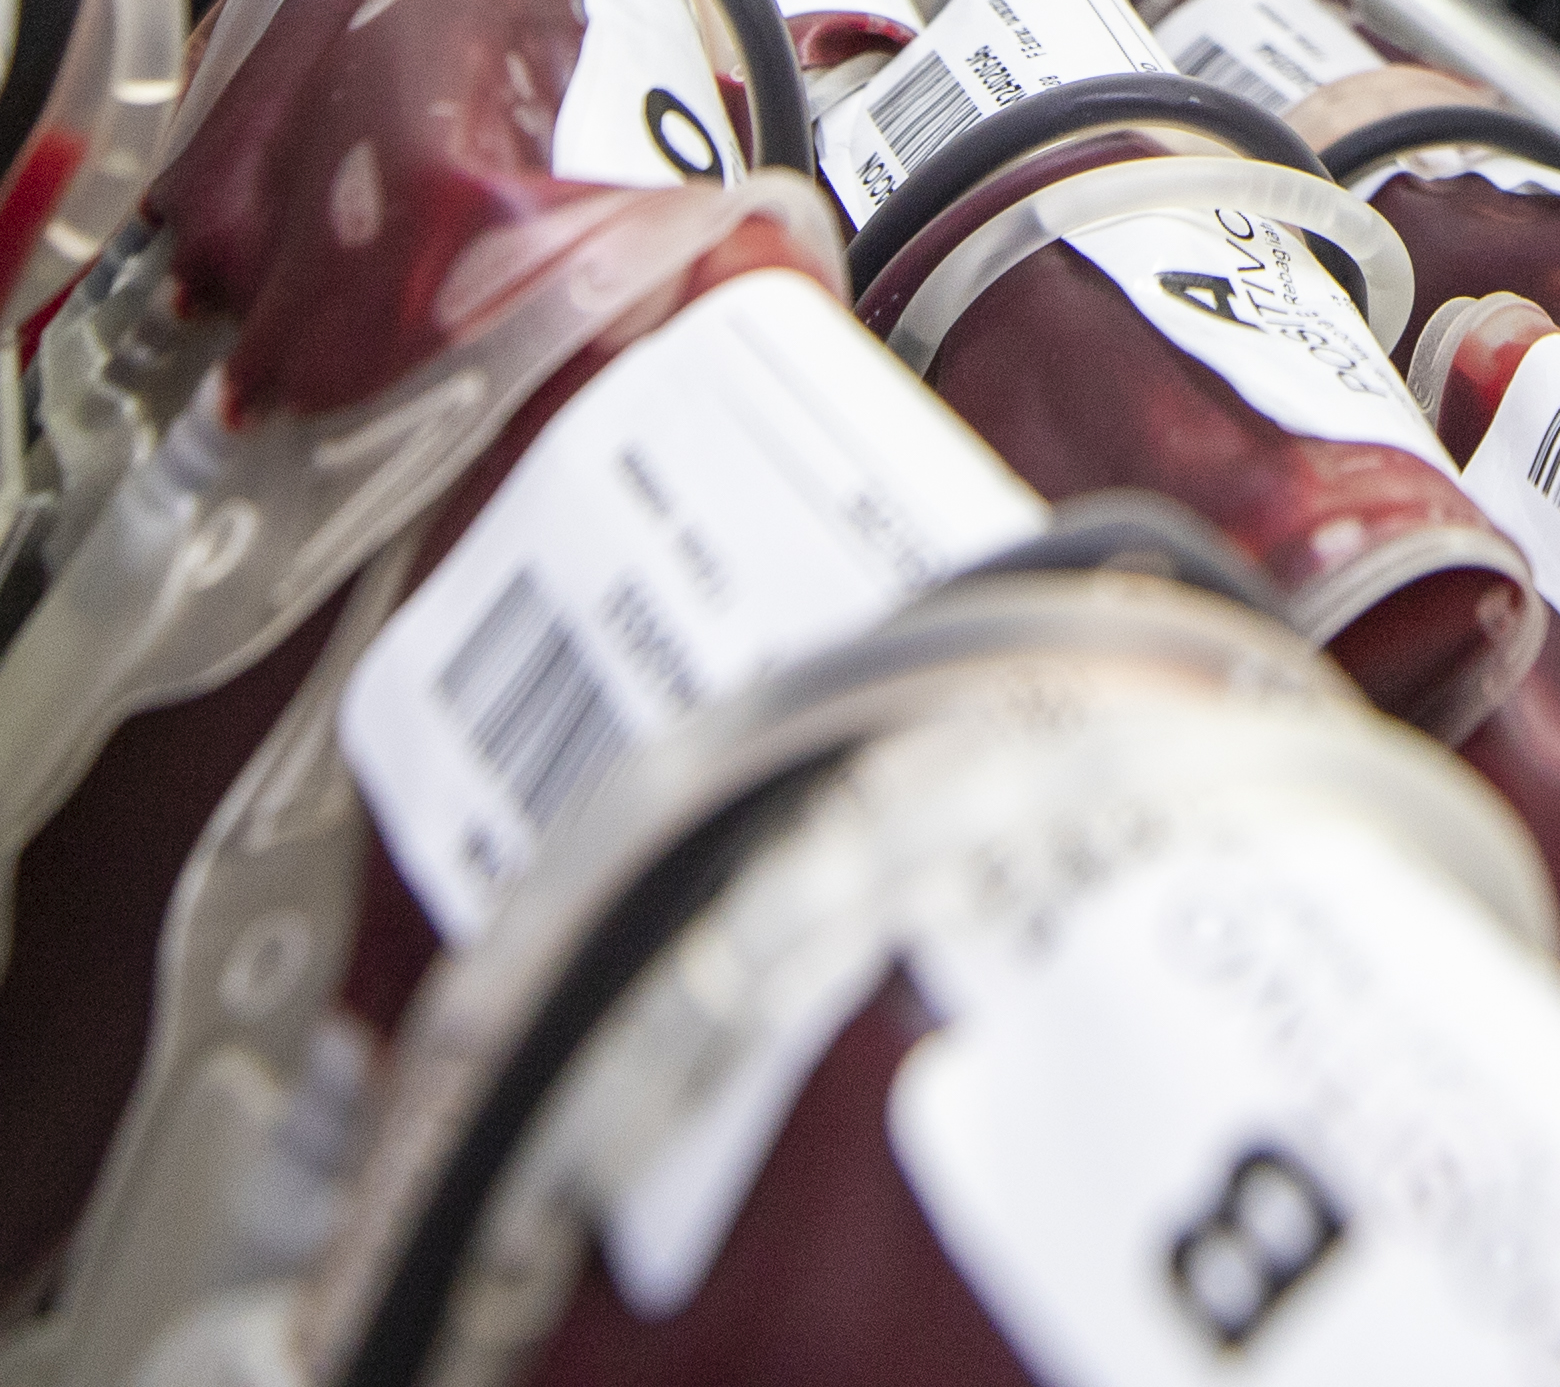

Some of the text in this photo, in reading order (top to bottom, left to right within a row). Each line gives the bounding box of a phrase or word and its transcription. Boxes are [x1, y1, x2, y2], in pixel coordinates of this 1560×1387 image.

[965, 44, 1028, 108] M24020546
[645, 88, 724, 188] O
[854, 150, 896, 207] ACION
[1152, 269, 1268, 334] A
[1166, 1139, 1346, 1349] B
